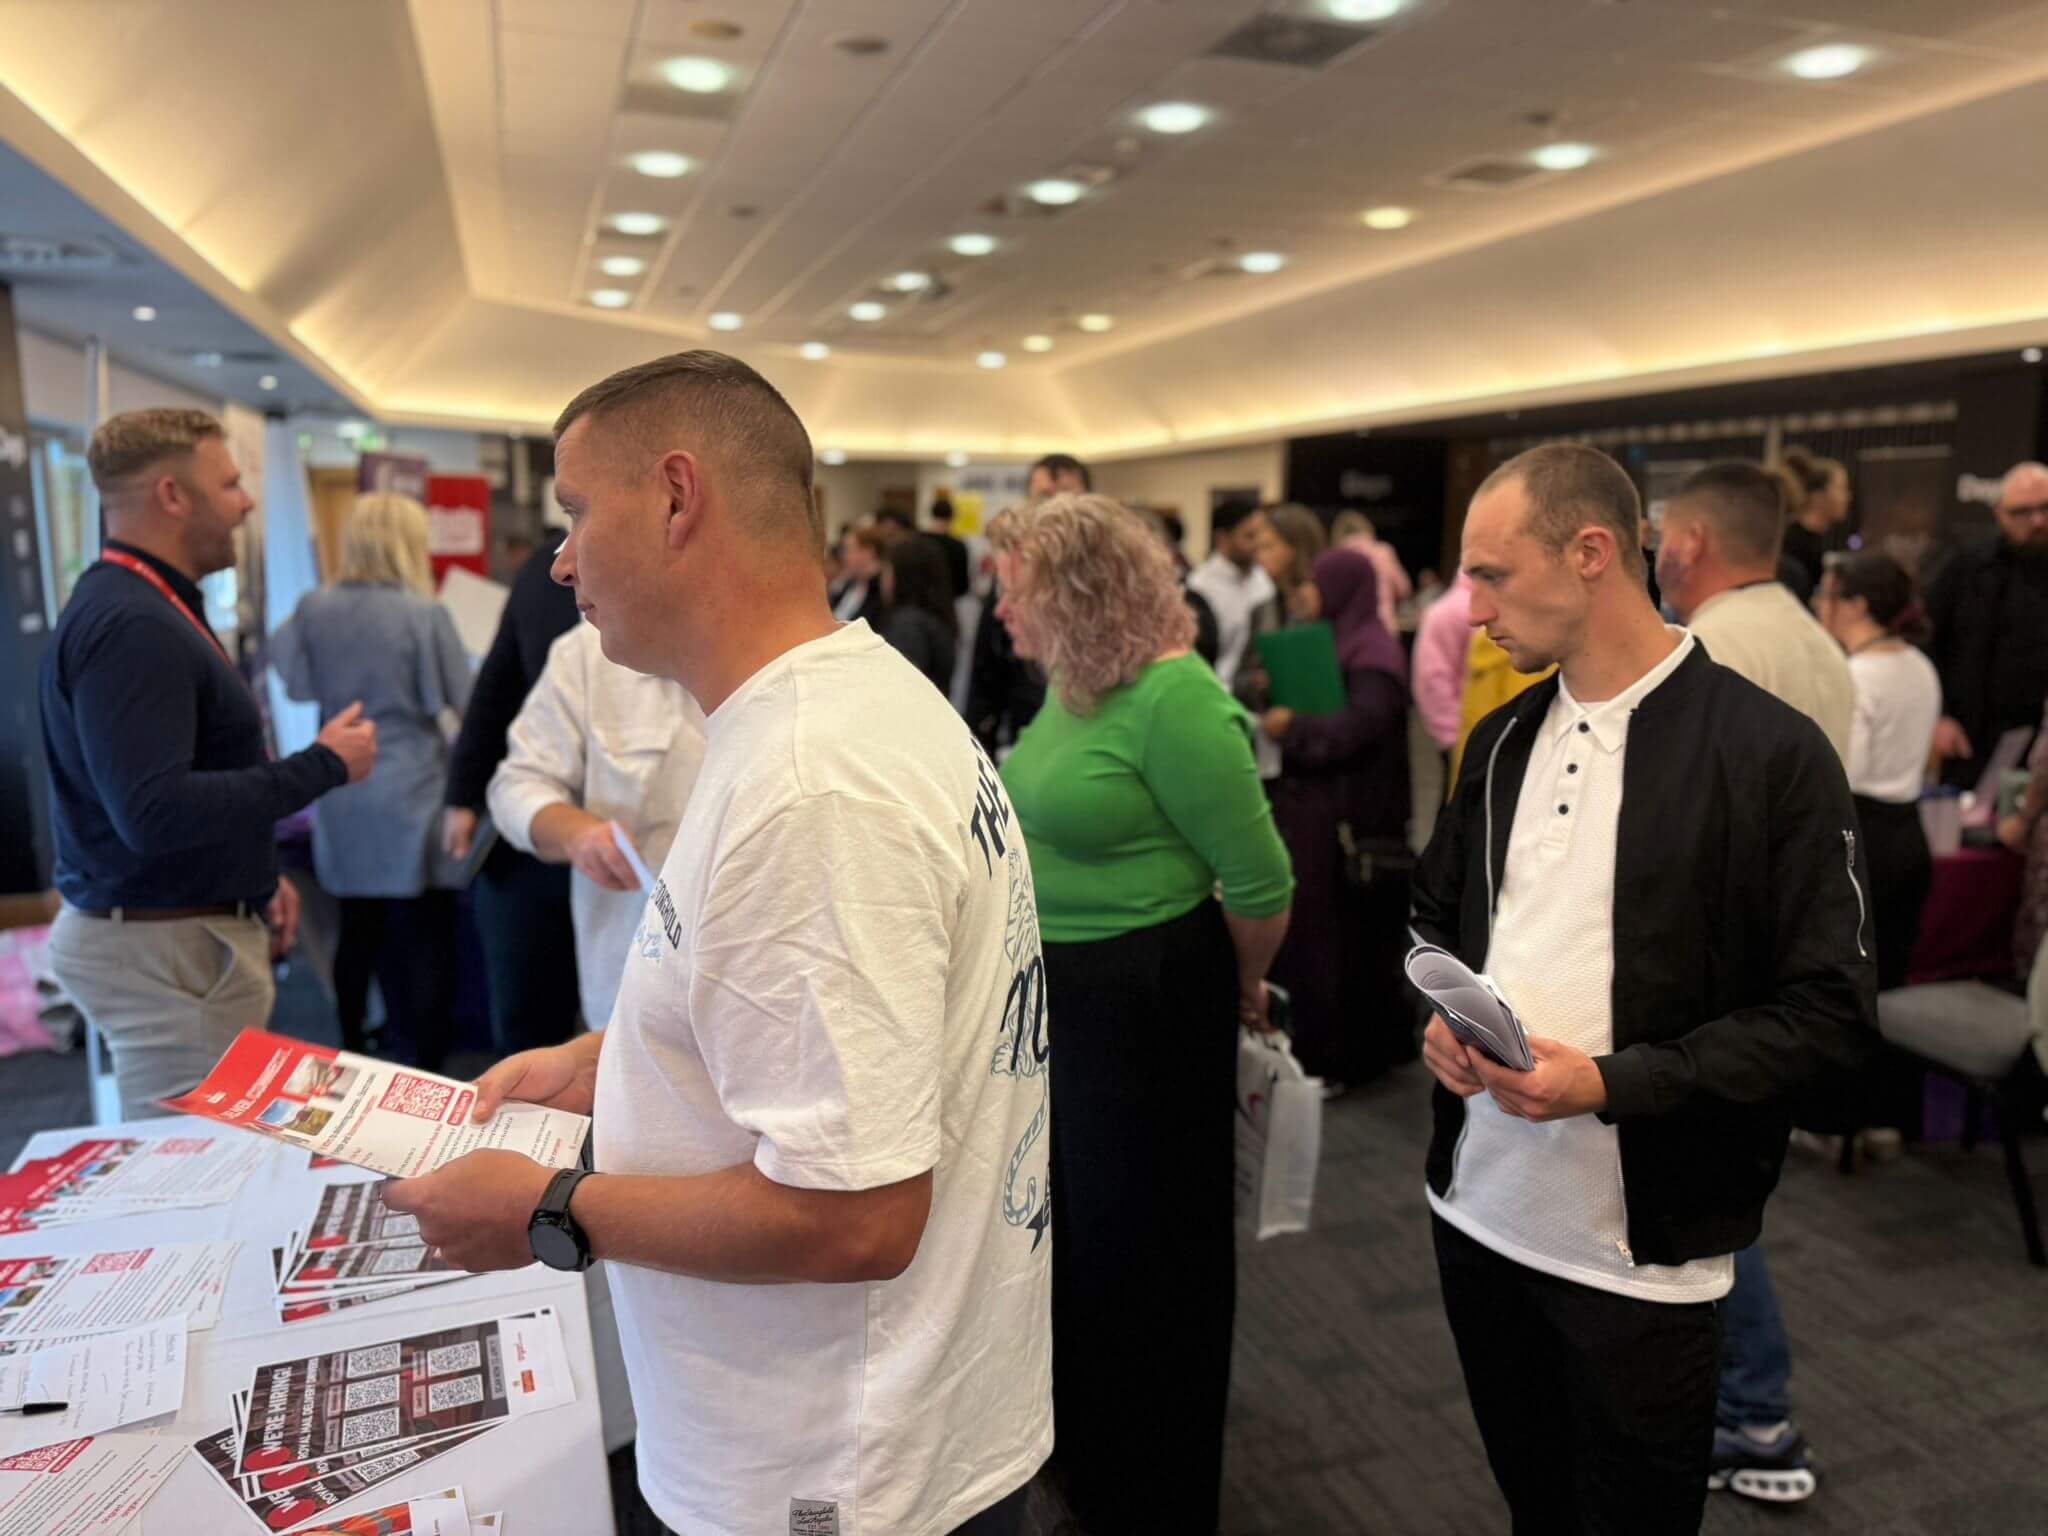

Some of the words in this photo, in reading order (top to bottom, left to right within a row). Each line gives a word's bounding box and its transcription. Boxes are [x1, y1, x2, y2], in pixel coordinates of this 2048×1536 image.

[266, 1365, 292, 1413] HIRING!
[301, 1382, 316, 1416] DELIVERY
[260, 1413, 285, 1456] WE'RE
[300, 1414, 312, 1434] MAIL
[296, 1432, 311, 1460] ROYAL
